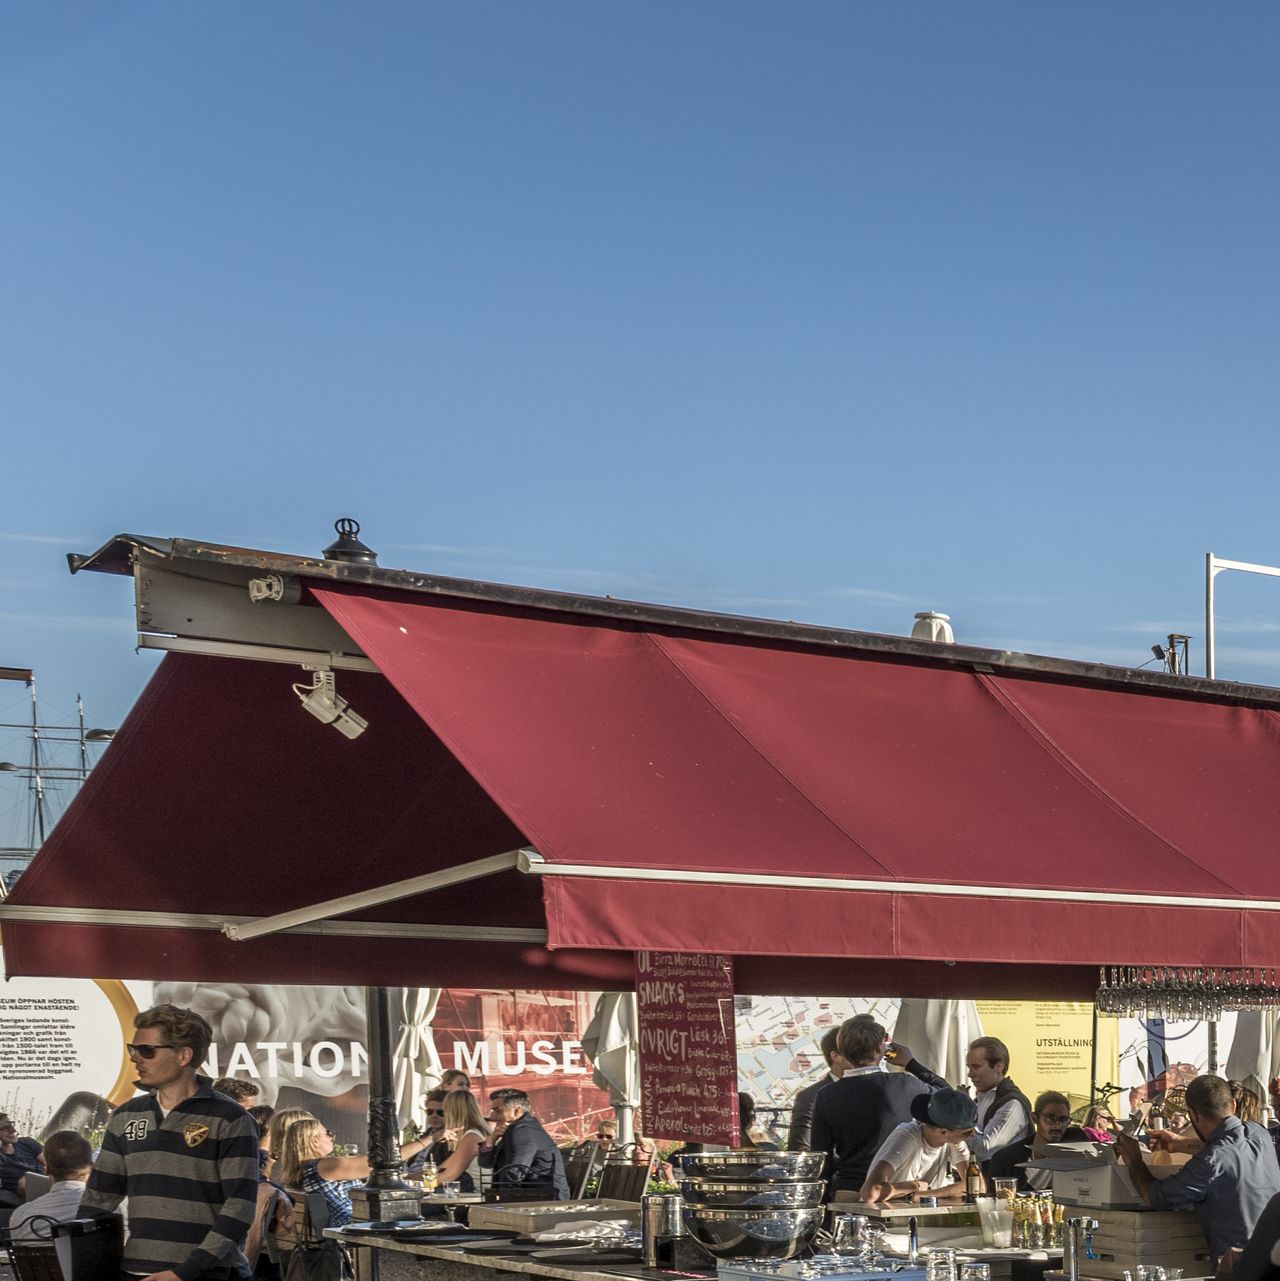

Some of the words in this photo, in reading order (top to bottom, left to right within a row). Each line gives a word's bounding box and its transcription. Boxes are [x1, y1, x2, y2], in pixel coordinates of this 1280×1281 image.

[640, 981, 685, 1007] SNACKS
[640, 1022, 688, 1061] ÖVRIGT
[644, 1075, 654, 1134] DRINKAR
[124, 1119, 148, 1141] 49
